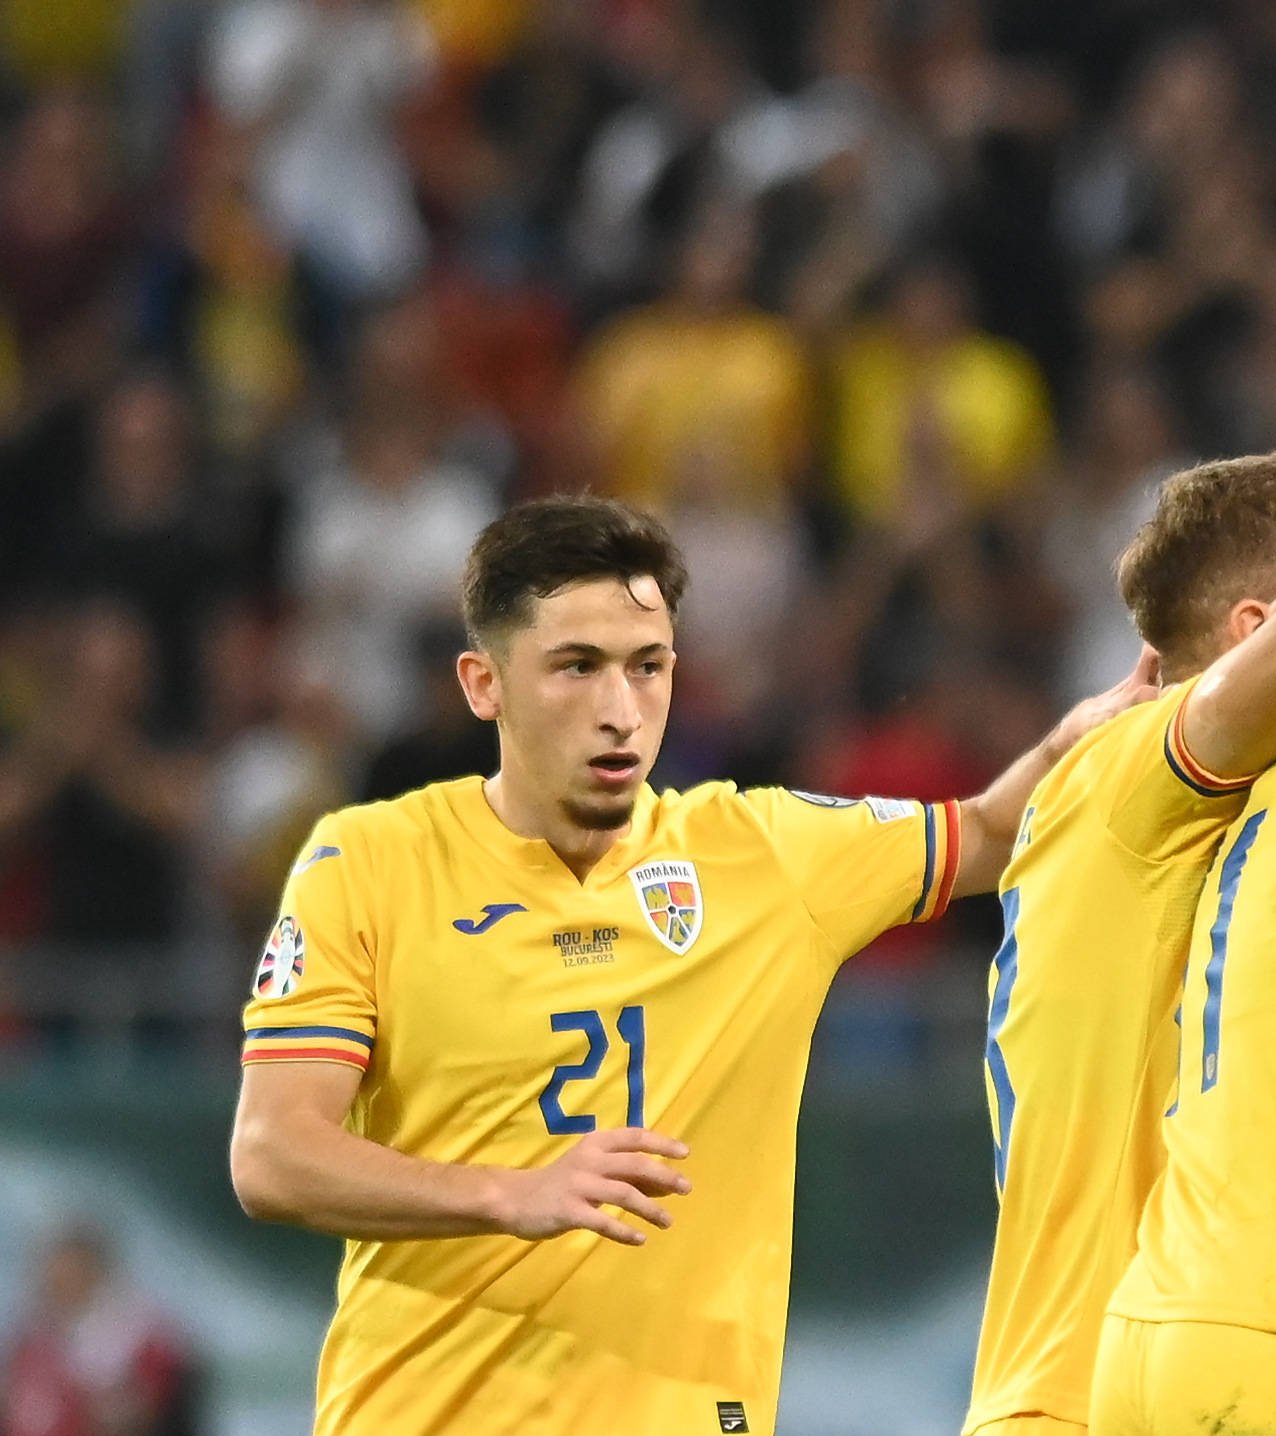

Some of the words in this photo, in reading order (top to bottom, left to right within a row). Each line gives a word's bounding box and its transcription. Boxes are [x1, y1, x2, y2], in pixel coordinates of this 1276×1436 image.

[552, 931, 581, 947] ROU
[592, 927, 620, 943] KOS
[538, 1005, 646, 1136] 21
